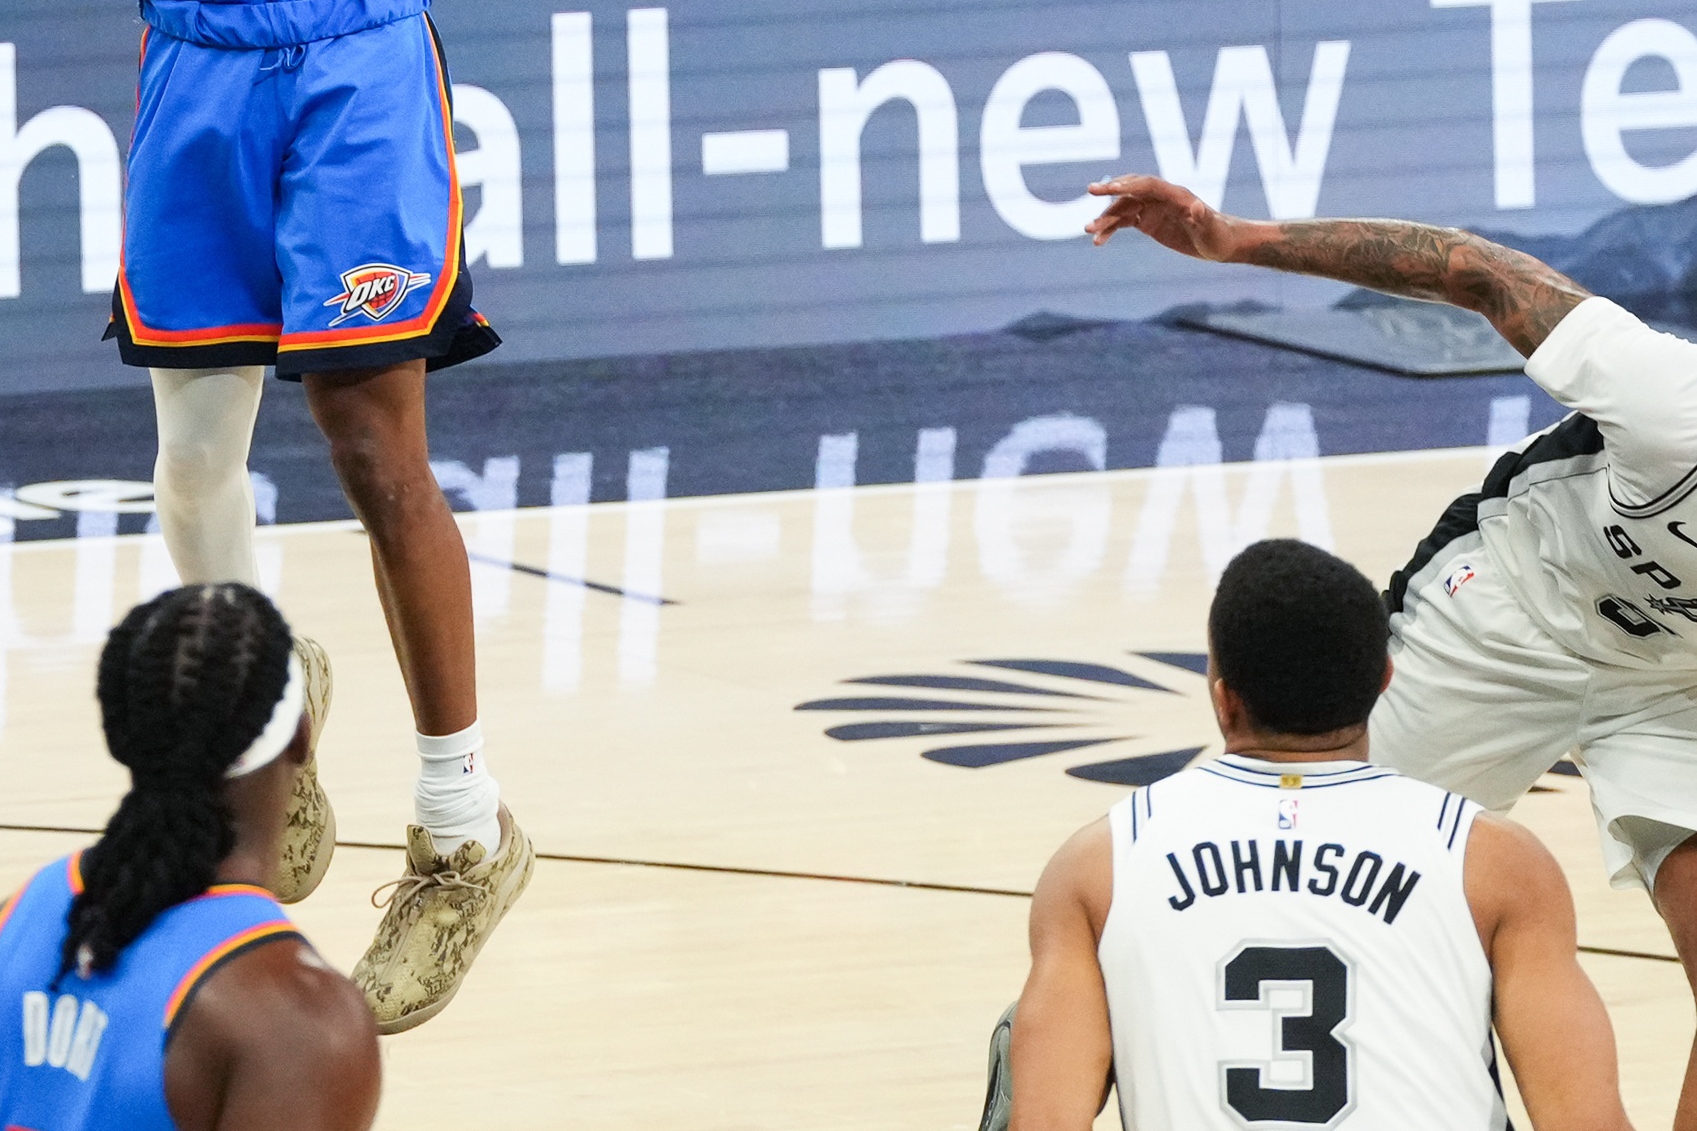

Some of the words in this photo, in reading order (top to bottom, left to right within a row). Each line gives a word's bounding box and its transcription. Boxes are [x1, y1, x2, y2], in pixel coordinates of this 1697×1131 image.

[345, 274, 396, 311] OKC
[1166, 839, 1422, 925] JOHNSON
[1214, 937, 1358, 1131] 3
